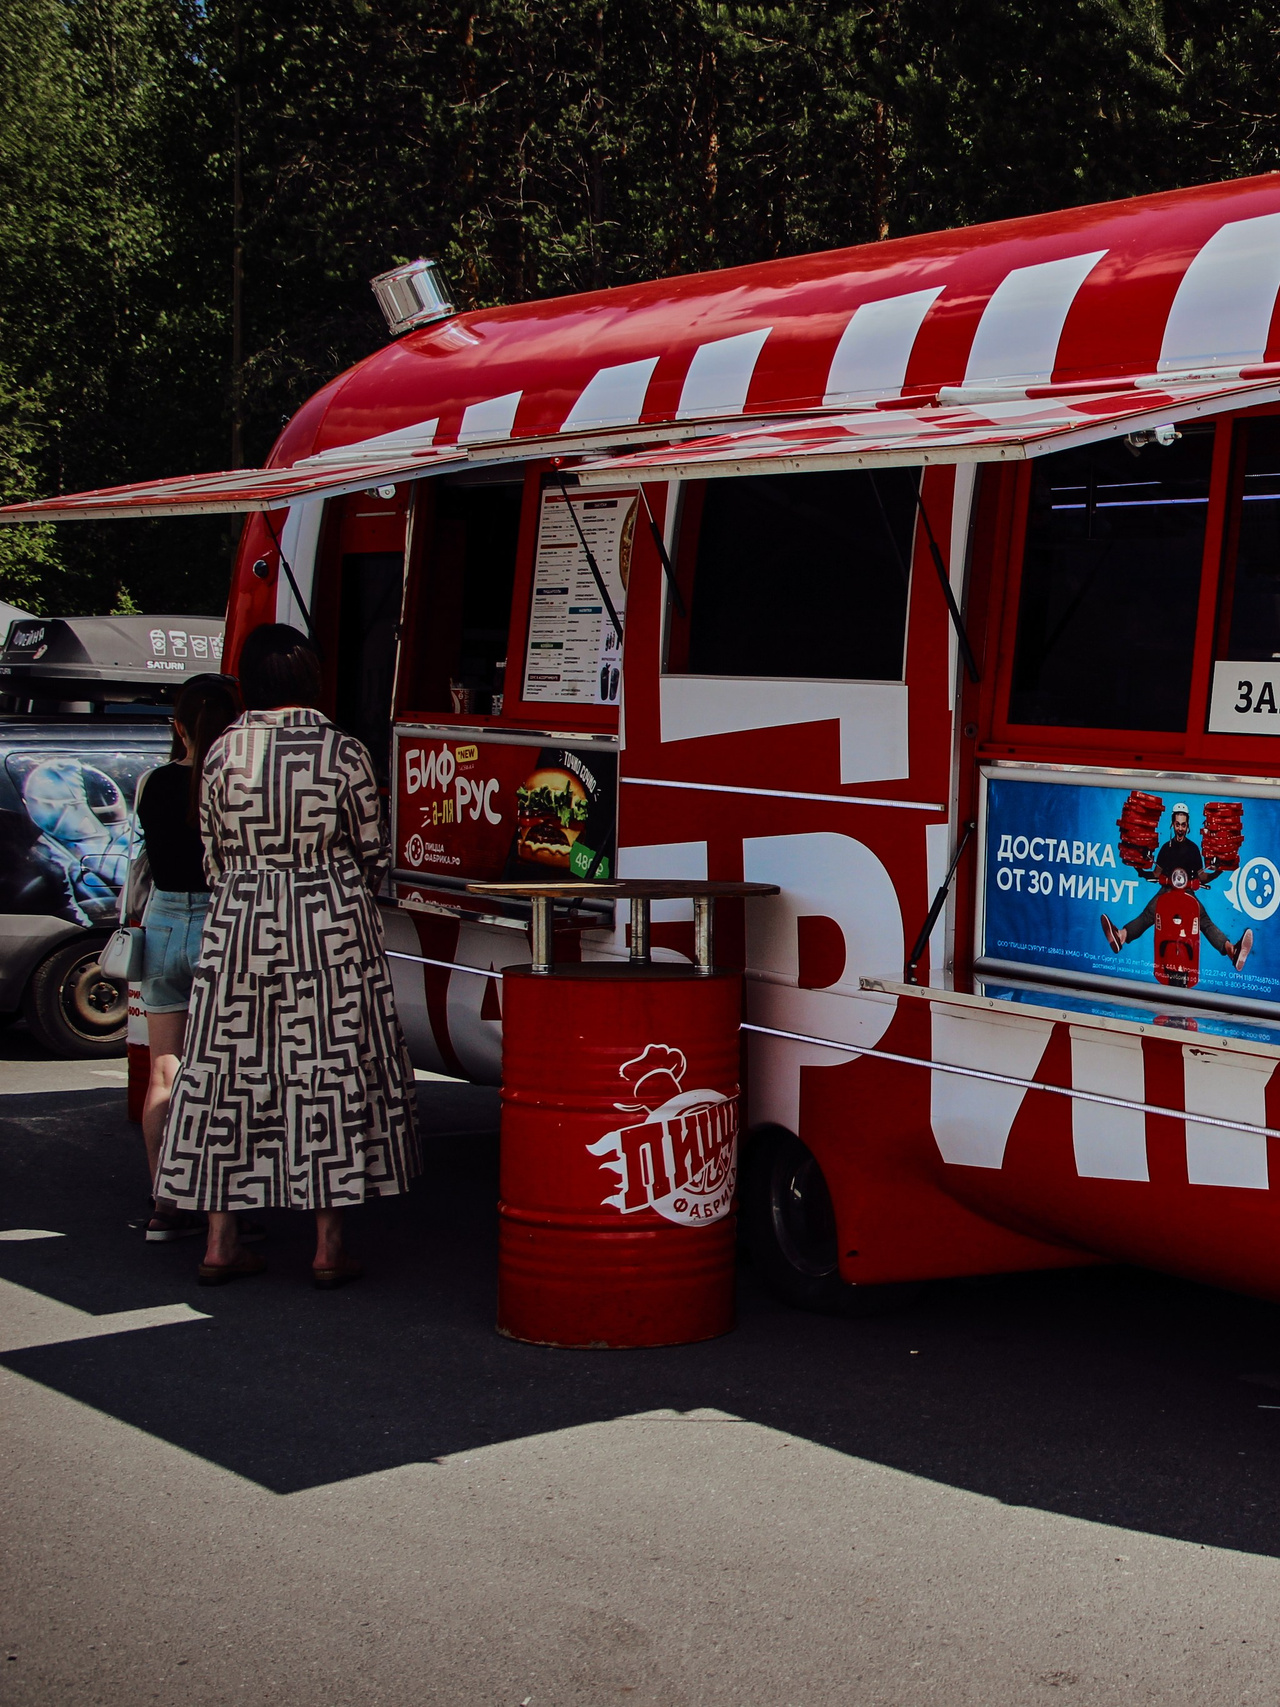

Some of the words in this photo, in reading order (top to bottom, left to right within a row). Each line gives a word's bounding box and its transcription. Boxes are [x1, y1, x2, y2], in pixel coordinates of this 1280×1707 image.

[147, 660, 185, 671] SATURN
[405, 743, 456, 794] БИФ
[455, 777, 502, 825] РУС
[424, 852, 461, 866] ФАБРИКА.РФ
[425, 842, 445, 853] ПИЦЦА
[997, 834, 1116, 868] ДОСТАВКА
[997, 866, 1028, 893] ОТ
[1029, 871, 1052, 896] 30
[1058, 875, 1139, 905] МИНУТ
[1225, 982, 1272, 993] 8-800-5-500-600
[619, 1099, 740, 1210] ПИЦЦ
